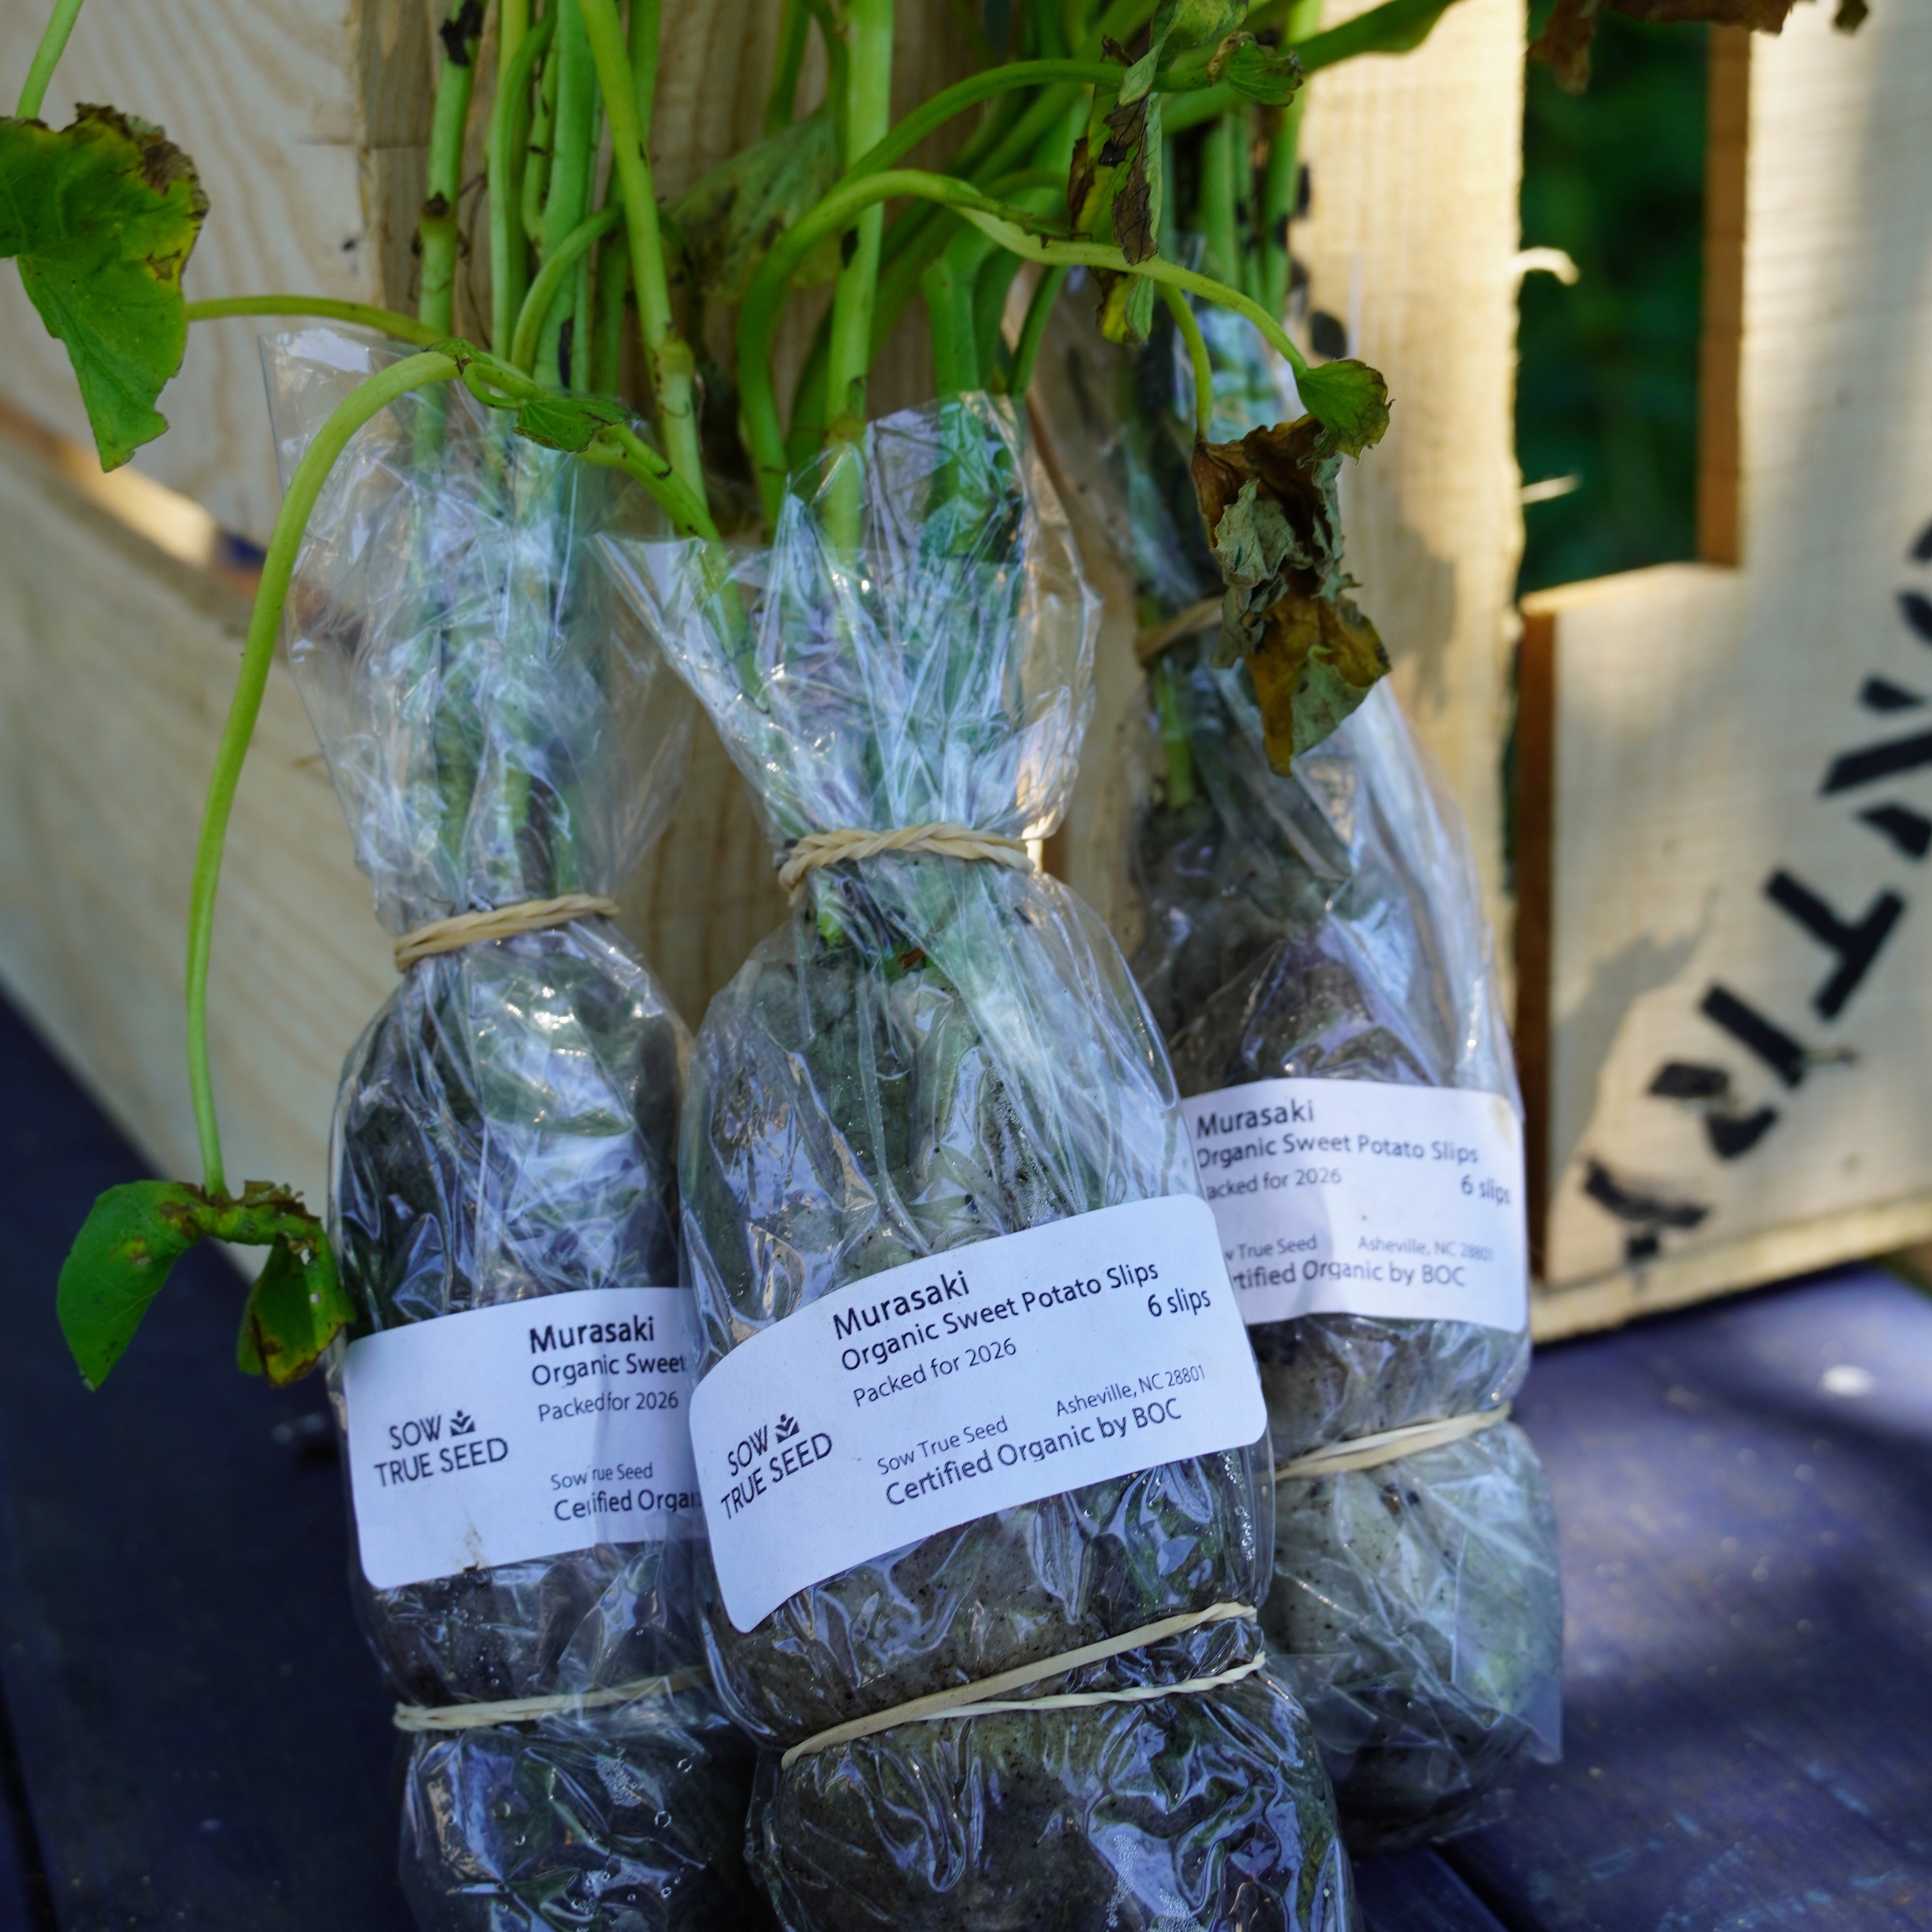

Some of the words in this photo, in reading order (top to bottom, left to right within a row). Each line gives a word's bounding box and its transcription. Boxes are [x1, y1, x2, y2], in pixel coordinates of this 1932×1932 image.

[1584, 514, 1932, 1262] NTRY
[1197, 1098, 1314, 1137] Murasaki
[1283, 1133, 1351, 1153] Sweet
[1357, 1135, 1424, 1159] Potato
[1431, 1141, 1478, 1165] Slips
[1207, 1175, 1258, 1200] acked
[1263, 1172, 1289, 1190] for
[1295, 1167, 1342, 1185] 2026
[1461, 1174, 1473, 1195] 6
[1479, 1178, 1511, 1207] slips
[1237, 1243, 1273, 1260] True
[1277, 1234, 1317, 1254] Seed
[1357, 1235, 1430, 1256] Asheville,
[1434, 1240, 1455, 1256] NC
[1233, 1262, 1296, 1290] rtified
[1304, 1260, 1383, 1281] Organic
[1390, 1262, 1414, 1286] by
[1422, 1264, 1465, 1287] BOC
[833, 1270, 969, 1339] Murasaki
[841, 1323, 939, 1370] Organic
[943, 1298, 1019, 1334] Sweet
[1022, 1278, 1101, 1312] Potato
[1107, 1264, 1159, 1288] Slips
[1148, 1294, 1163, 1317] 6
[1167, 1288, 1211, 1315] slips
[530, 1315, 654, 1354] Murasaki
[532, 1354, 619, 1385] Organic
[626, 1353, 686, 1374] Sweet
[853, 1364, 927, 1407] Packed
[930, 1356, 960, 1378] for
[965, 1337, 1017, 1367] 2026
[539, 1392, 605, 1421] Packed
[607, 1392, 630, 1410] for
[636, 1391, 679, 1409] 2026
[1057, 1383, 1137, 1417] Asheville,
[1138, 1373, 1164, 1393] NC
[1165, 1364, 1206, 1387] 28801
[389, 1415, 441, 1449] SOW
[877, 1448, 915, 1475] Sow
[918, 1433, 961, 1459] True
[964, 1415, 1009, 1444] Seed
[374, 1452, 434, 1486] TRUE
[440, 1437, 508, 1473] SEED
[728, 1424, 768, 1477] SOW
[886, 1449, 994, 1505] Certified
[997, 1425, 1095, 1465] Organic
[1097, 1416, 1127, 1438] by
[1133, 1398, 1182, 1428] BOC
[551, 1472, 587, 1490] Sow
[587, 1465, 613, 1480] rue
[616, 1462, 653, 1479] Seed
[721, 1467, 767, 1520] TRUE
[769, 1432, 833, 1483] SEED
[554, 1490, 631, 1521] Ceified
